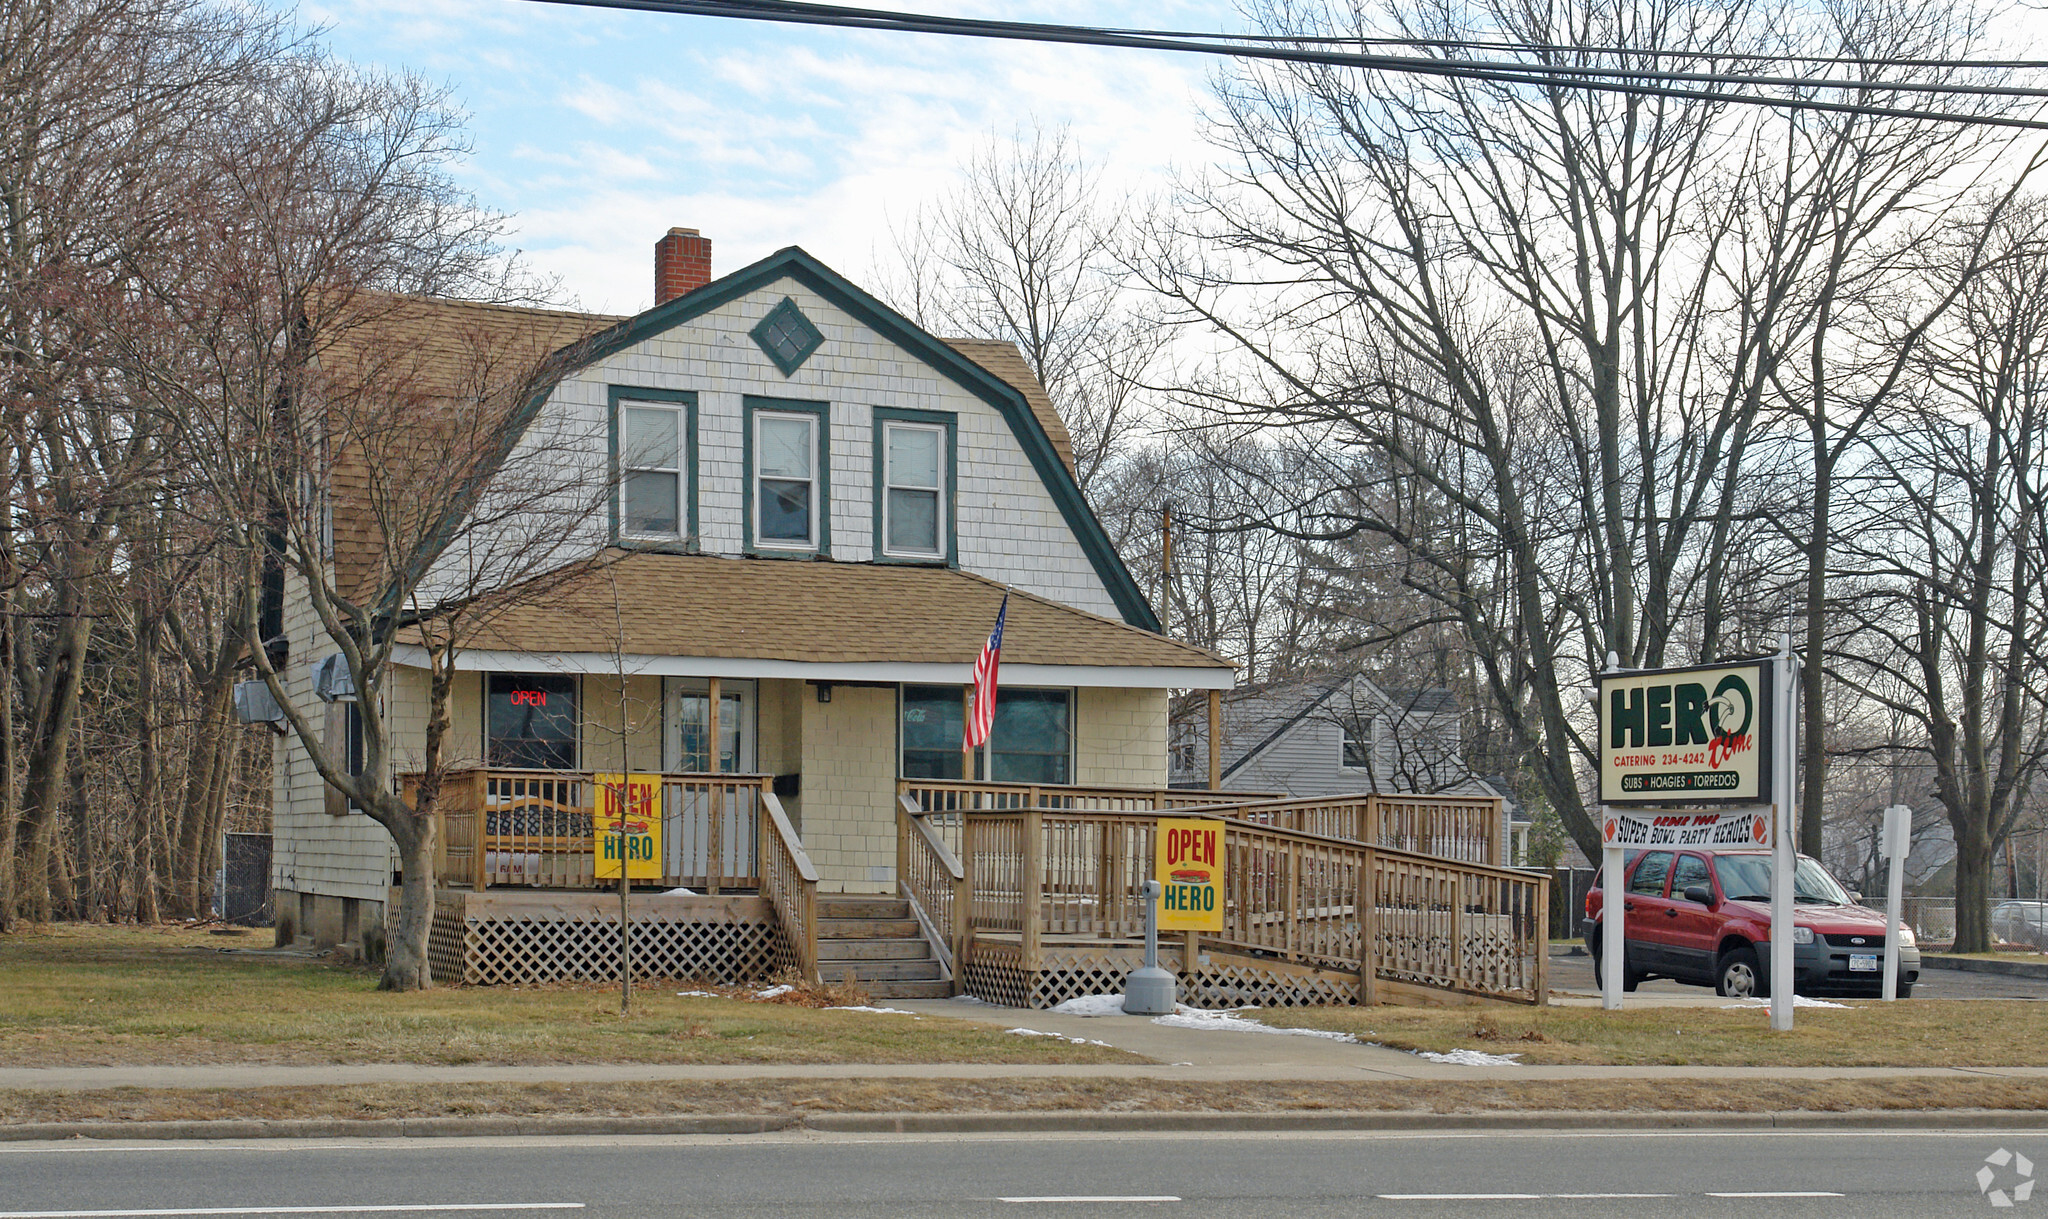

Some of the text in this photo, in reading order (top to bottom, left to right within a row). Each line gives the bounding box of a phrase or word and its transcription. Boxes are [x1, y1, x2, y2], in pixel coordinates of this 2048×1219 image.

[511, 690, 546, 706] OPEN
[1611, 675, 1752, 748] HERO
[1614, 752, 1704, 767] CATERING 234-4242
[1624, 774, 1736, 789] SUBS HOAGIES TORPEDOS
[1618, 813, 1751, 844] SUPER BOWL PARTY HEROES
[1652, 814, 1720, 826] ORDER YOUR
[1167, 828, 1216, 867] OPEN
[1165, 885, 1214, 911] HERO
